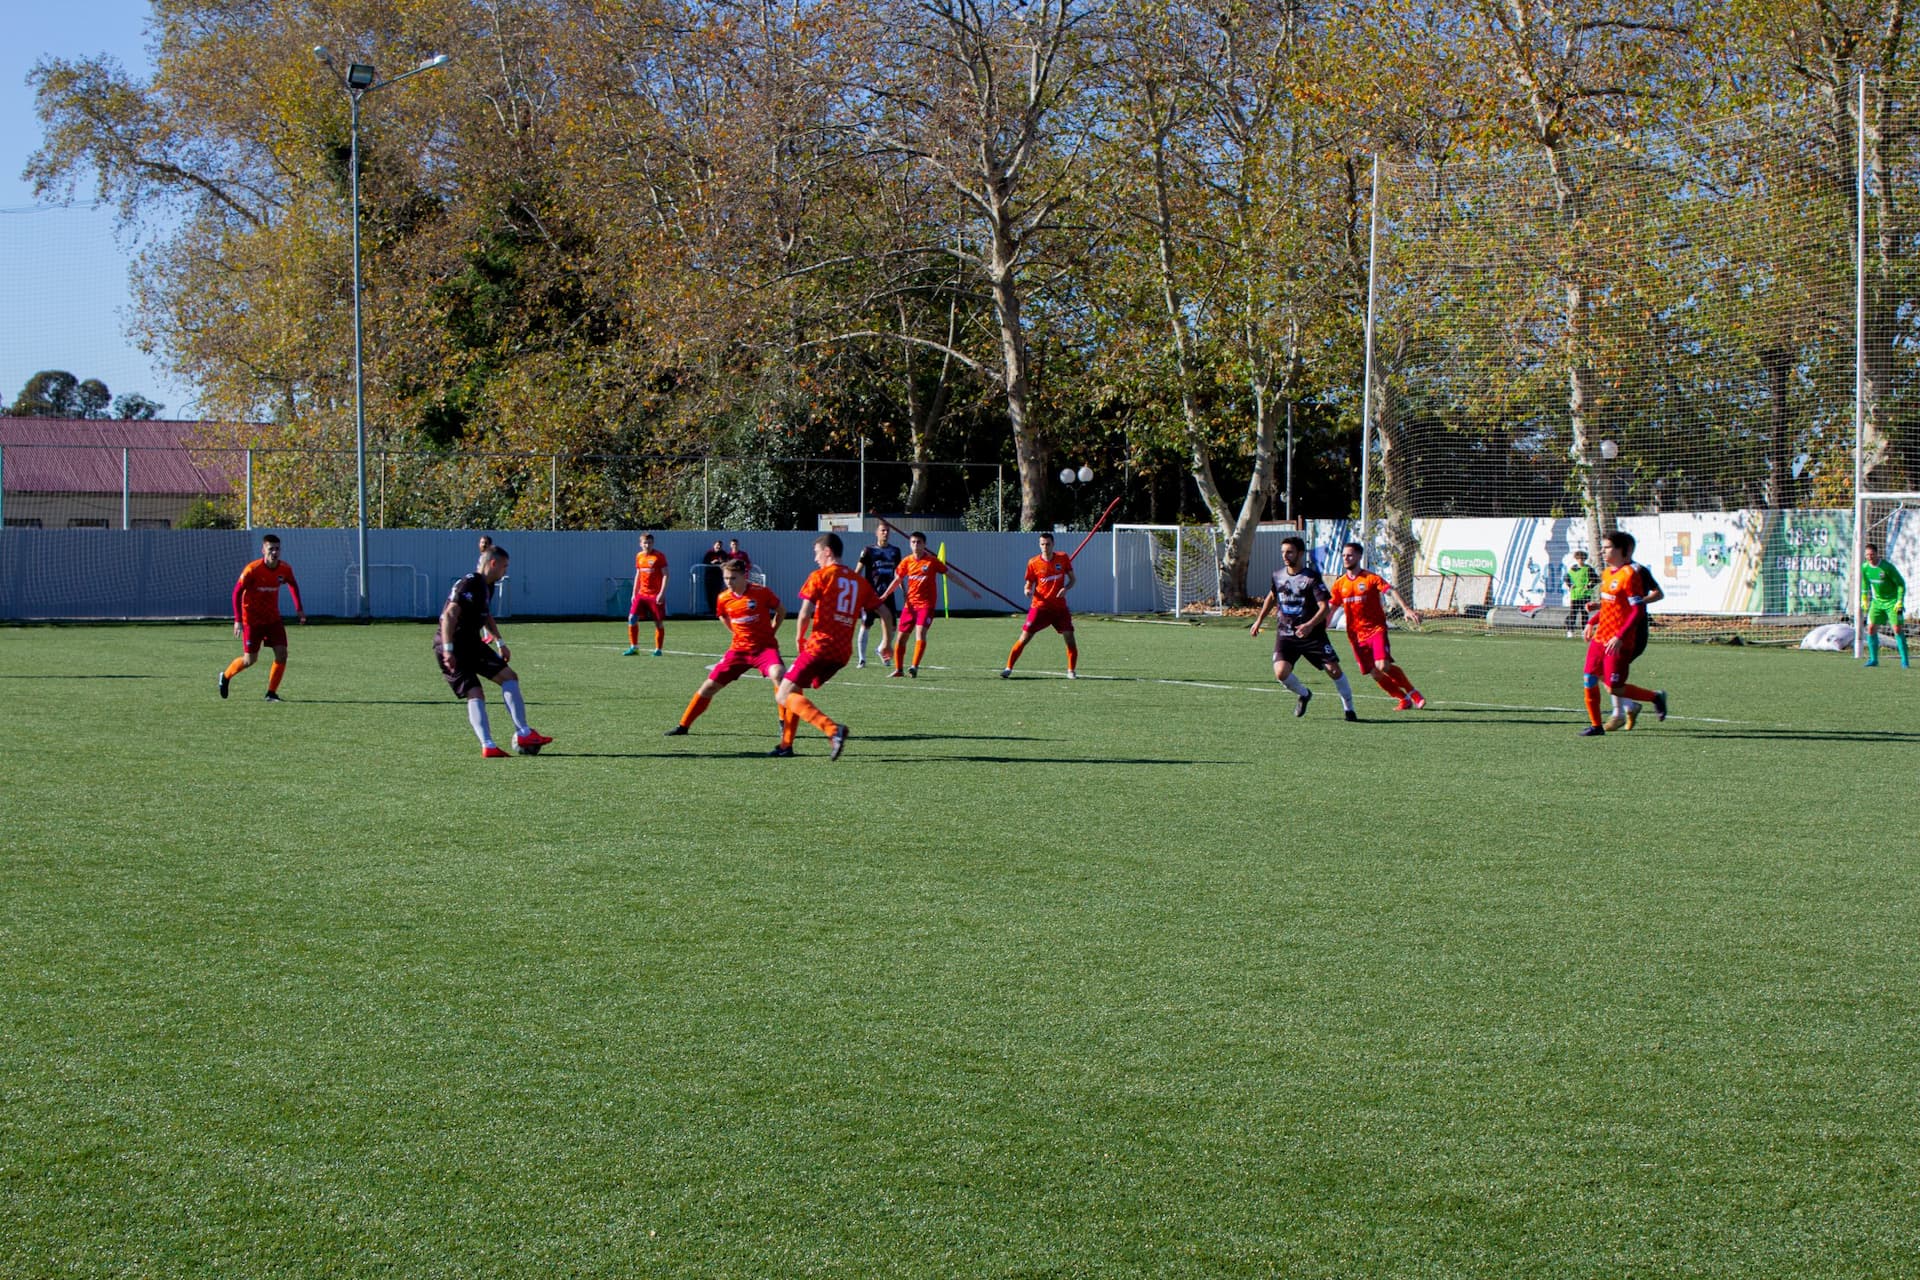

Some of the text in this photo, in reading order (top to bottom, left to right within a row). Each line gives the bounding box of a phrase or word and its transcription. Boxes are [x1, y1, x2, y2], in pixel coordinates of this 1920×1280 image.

[1787, 527, 1828, 546] 18-19
[837, 576, 859, 615] 21
[1798, 579, 1831, 597] Сочи
